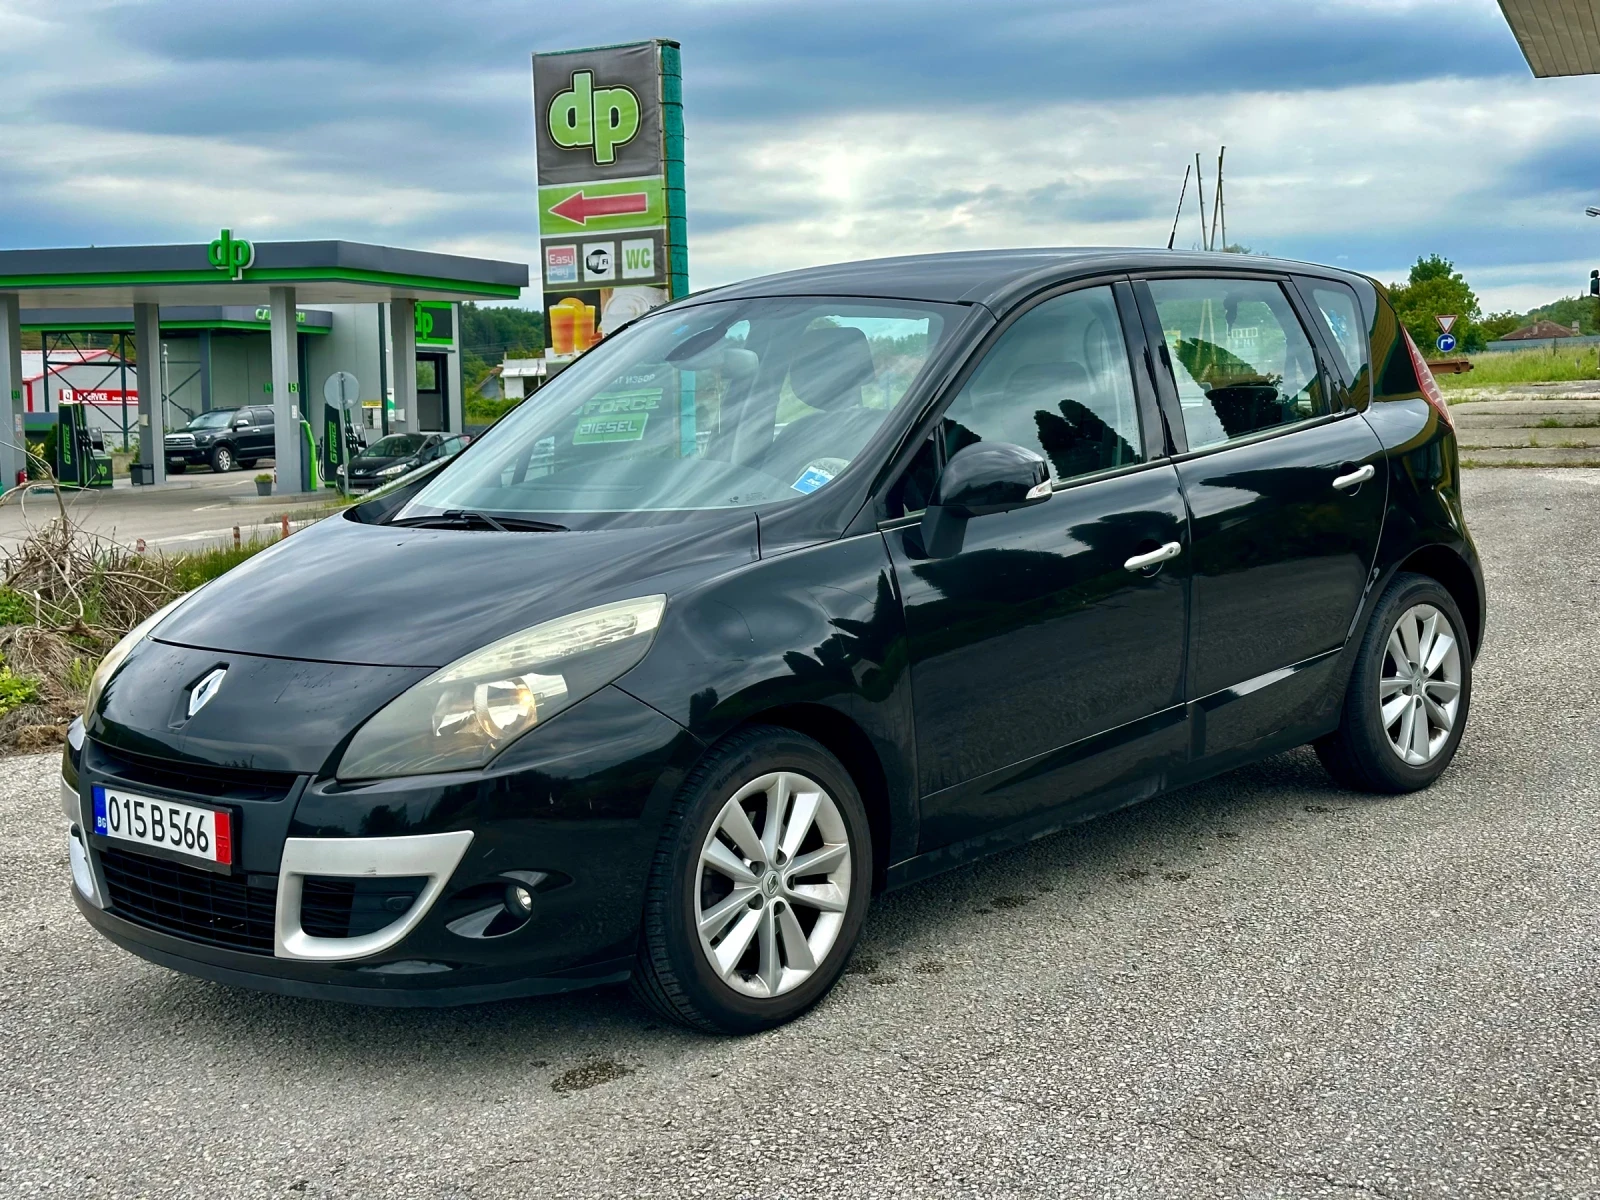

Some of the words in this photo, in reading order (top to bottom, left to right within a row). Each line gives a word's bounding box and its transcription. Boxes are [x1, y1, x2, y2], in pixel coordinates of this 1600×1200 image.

[548, 71, 640, 164] dp
[208, 228, 252, 280] dp
[549, 254, 574, 265] Easy
[626, 248, 651, 270] WC
[550, 267, 569, 278] Pay
[579, 420, 637, 435] DIESEL
[97, 816, 107, 828] BG
[108, 796, 209, 853] 015B566
